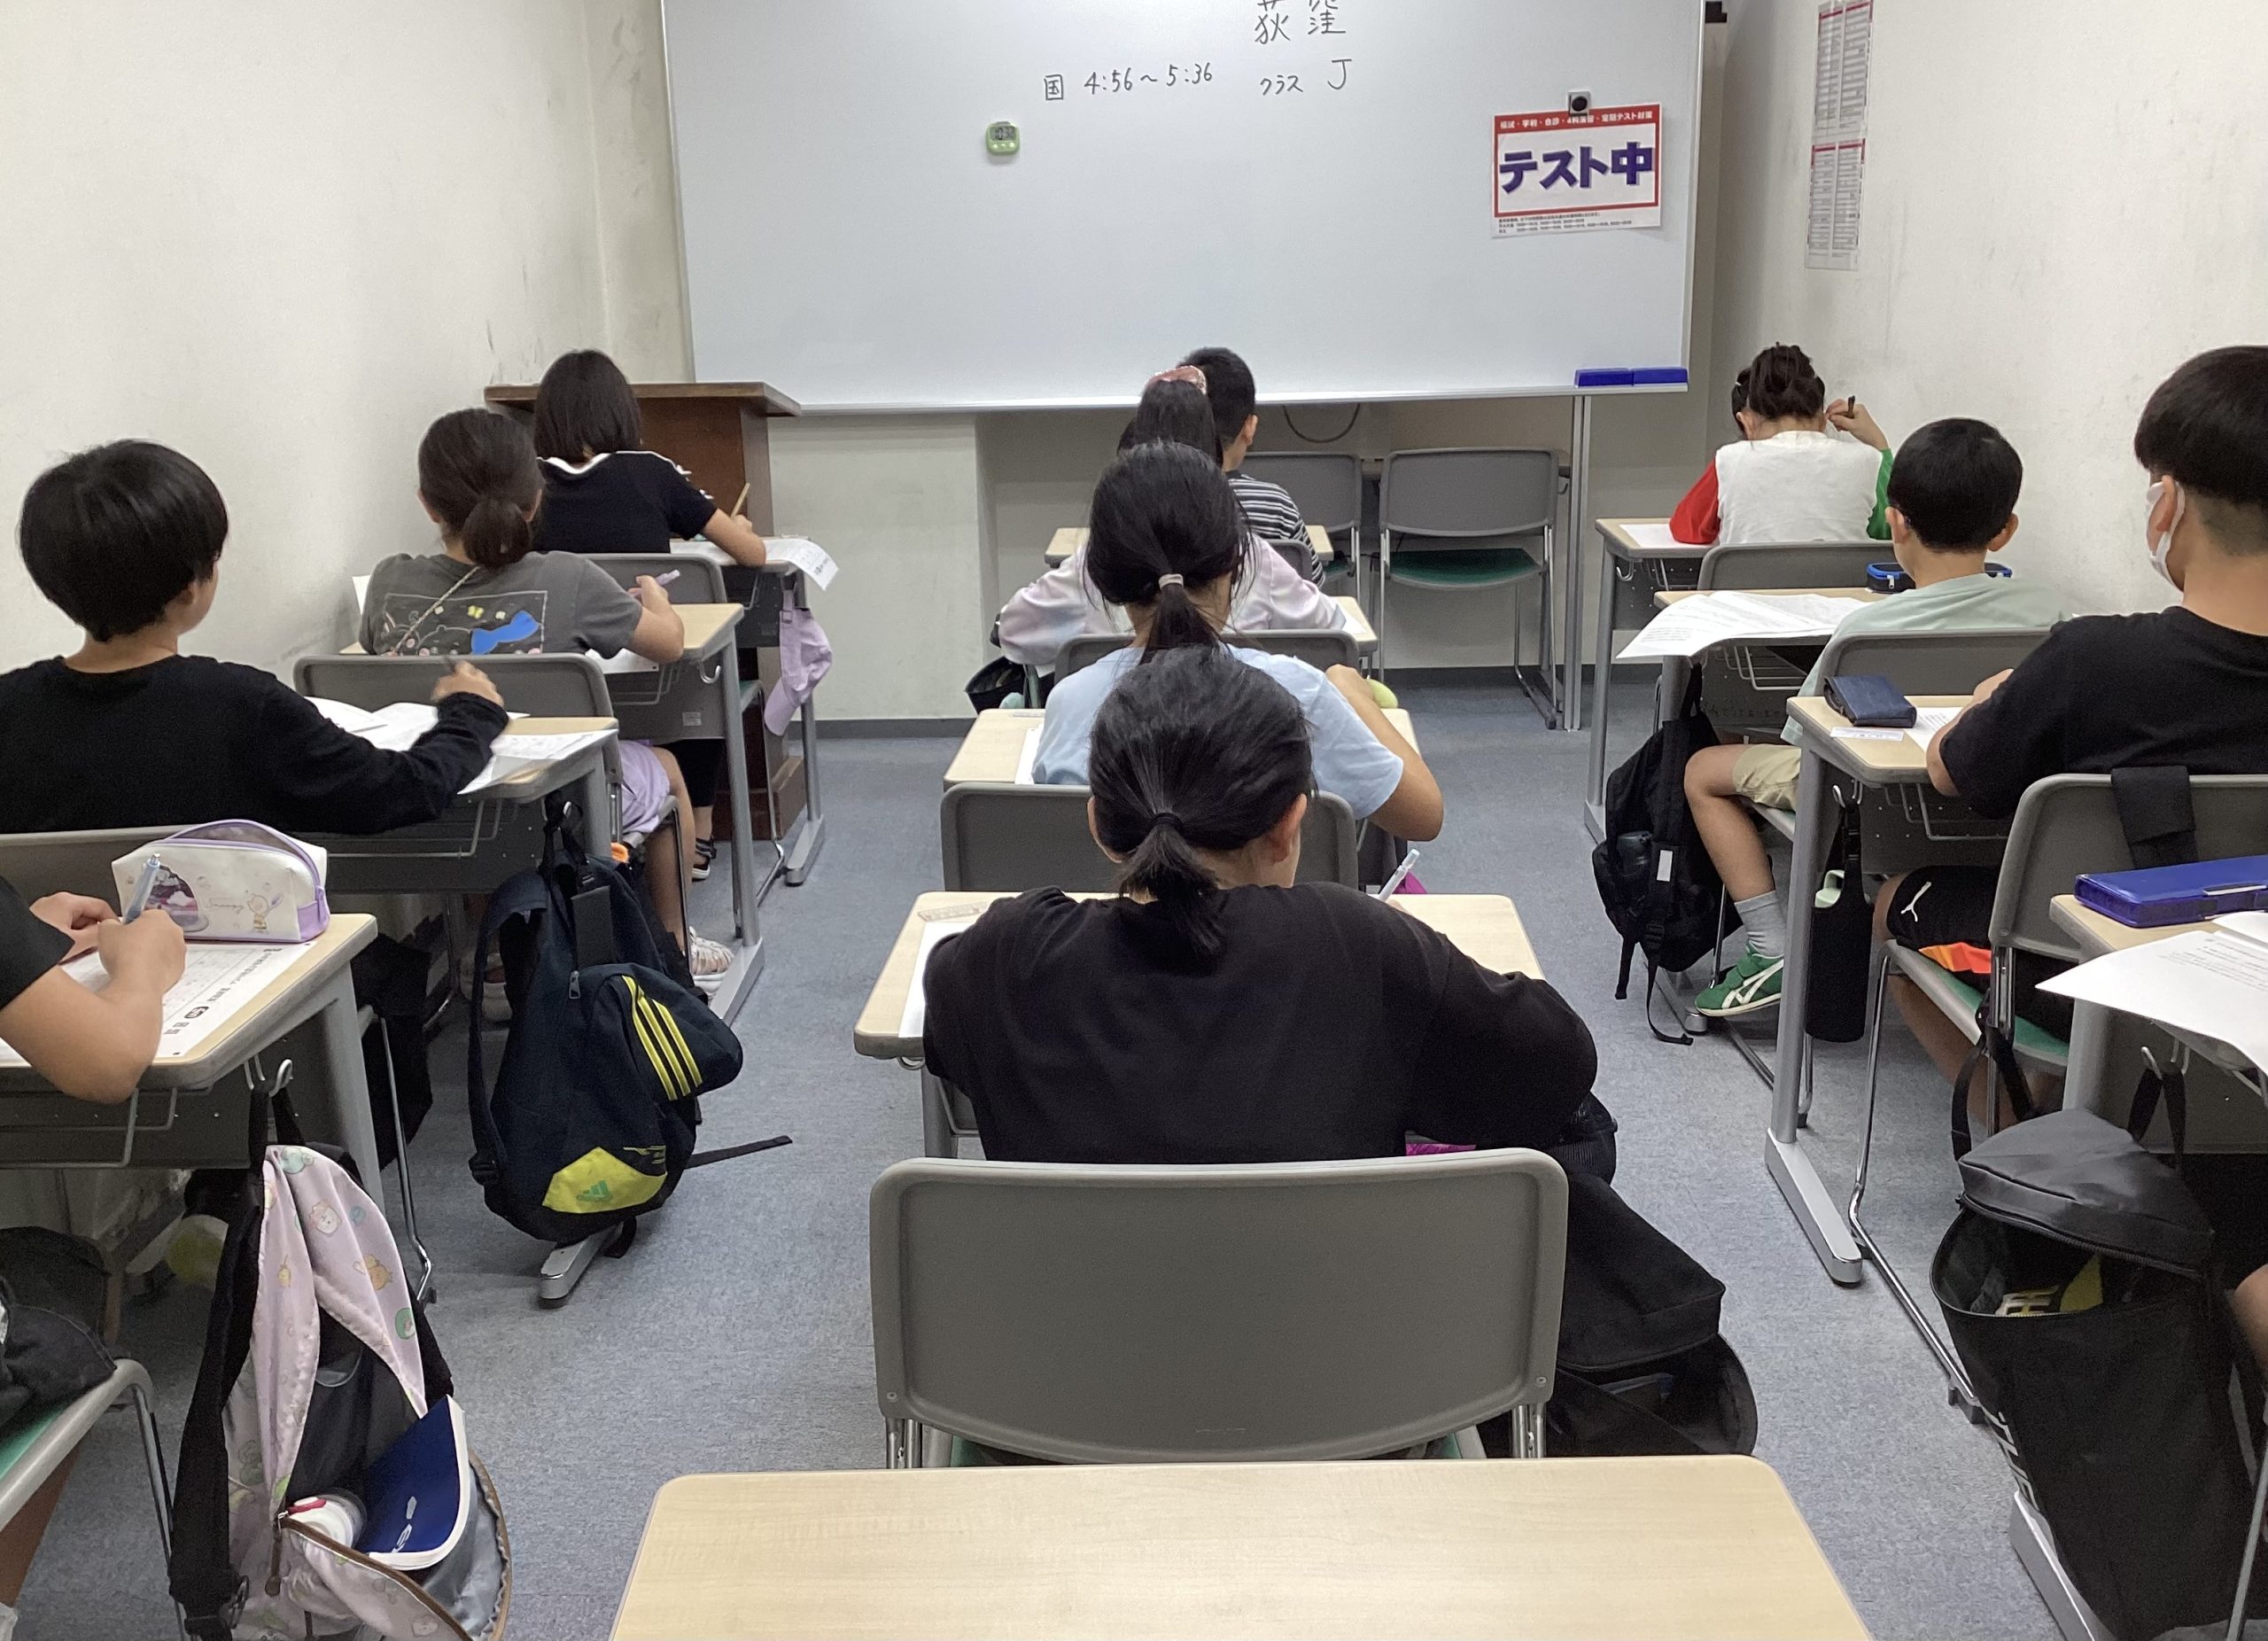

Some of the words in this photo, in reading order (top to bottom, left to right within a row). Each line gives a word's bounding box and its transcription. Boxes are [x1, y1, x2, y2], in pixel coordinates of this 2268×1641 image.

[1044, 74, 1064, 100] 国
[1260, 74, 1304, 95] クラス
[1327, 58, 1353, 89] J
[1499, 141, 1654, 194] テスト中
